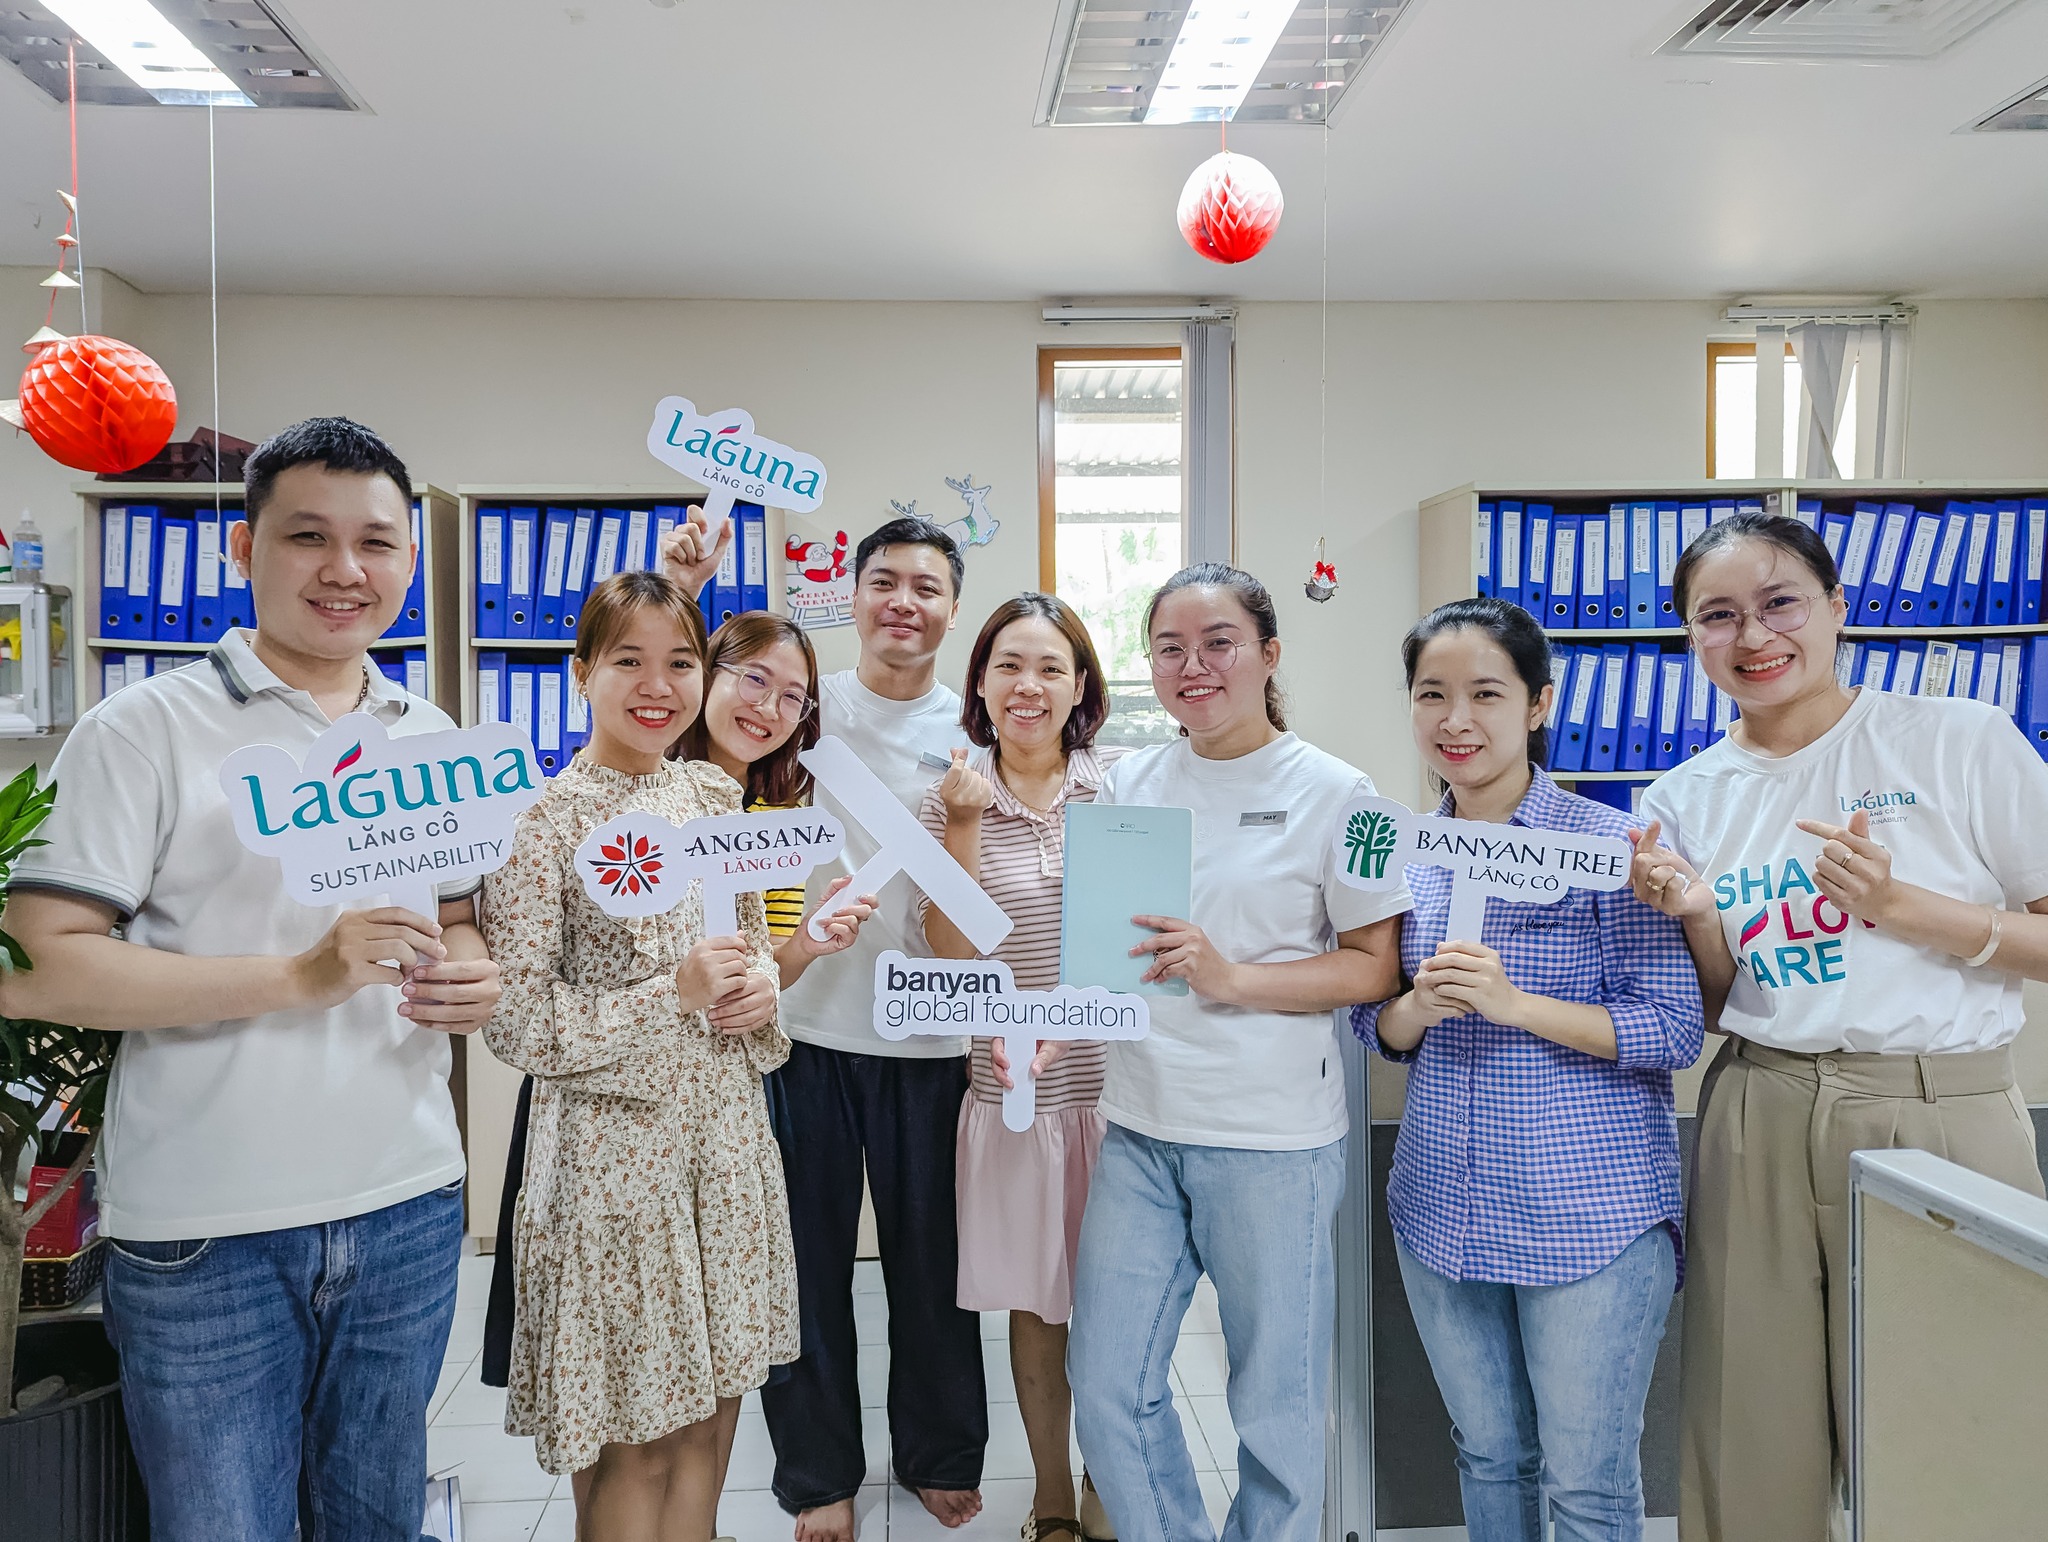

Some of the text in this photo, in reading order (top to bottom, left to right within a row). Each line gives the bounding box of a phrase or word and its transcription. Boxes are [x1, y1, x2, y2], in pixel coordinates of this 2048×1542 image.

[702, 467, 766, 499] LĂNG CÔ
[601, 548, 610, 575] CONTRACT
[1850, 558, 1858, 573] SAFETY
[1913, 558, 1921, 573] SAFETY
[1918, 538, 1927, 554] HEALTH
[796, 590, 835, 599] MERRY
[796, 595, 848, 606] CHRISTM
[1870, 670, 1878, 687] CHECK
[347, 810, 460, 852] LĂNG CÔ
[684, 824, 835, 857] ANGSANA
[310, 838, 504, 892] SUSTAINABILITY
[723, 851, 803, 875] LĂNG CÔ
[1416, 829, 1624, 878] BANYAN TREE
[1468, 864, 1559, 890] LĂNG CÔ
[1713, 858, 1816, 911] SHA
[1780, 895, 1876, 941] LO
[888, 964, 1002, 999] banyan
[886, 993, 1137, 1029] global foundation
